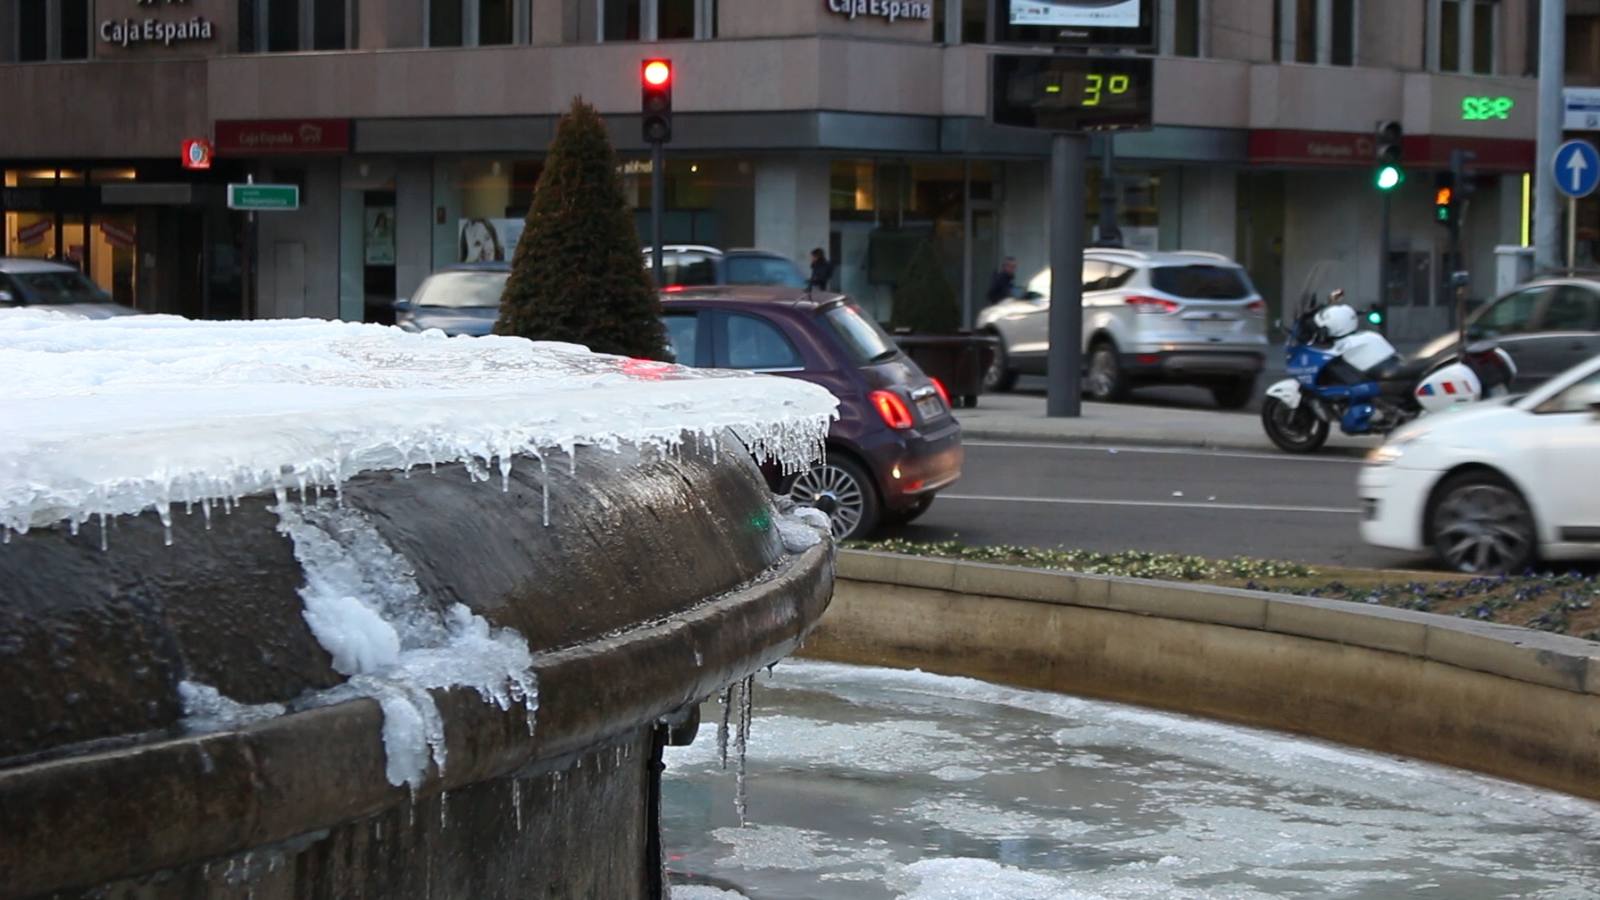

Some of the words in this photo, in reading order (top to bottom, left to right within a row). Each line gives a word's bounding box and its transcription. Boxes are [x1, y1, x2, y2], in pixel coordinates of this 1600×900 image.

[828, 0, 868, 19] Caja
[99, 18, 140, 47] Caja
[143, 16, 212, 46] España
